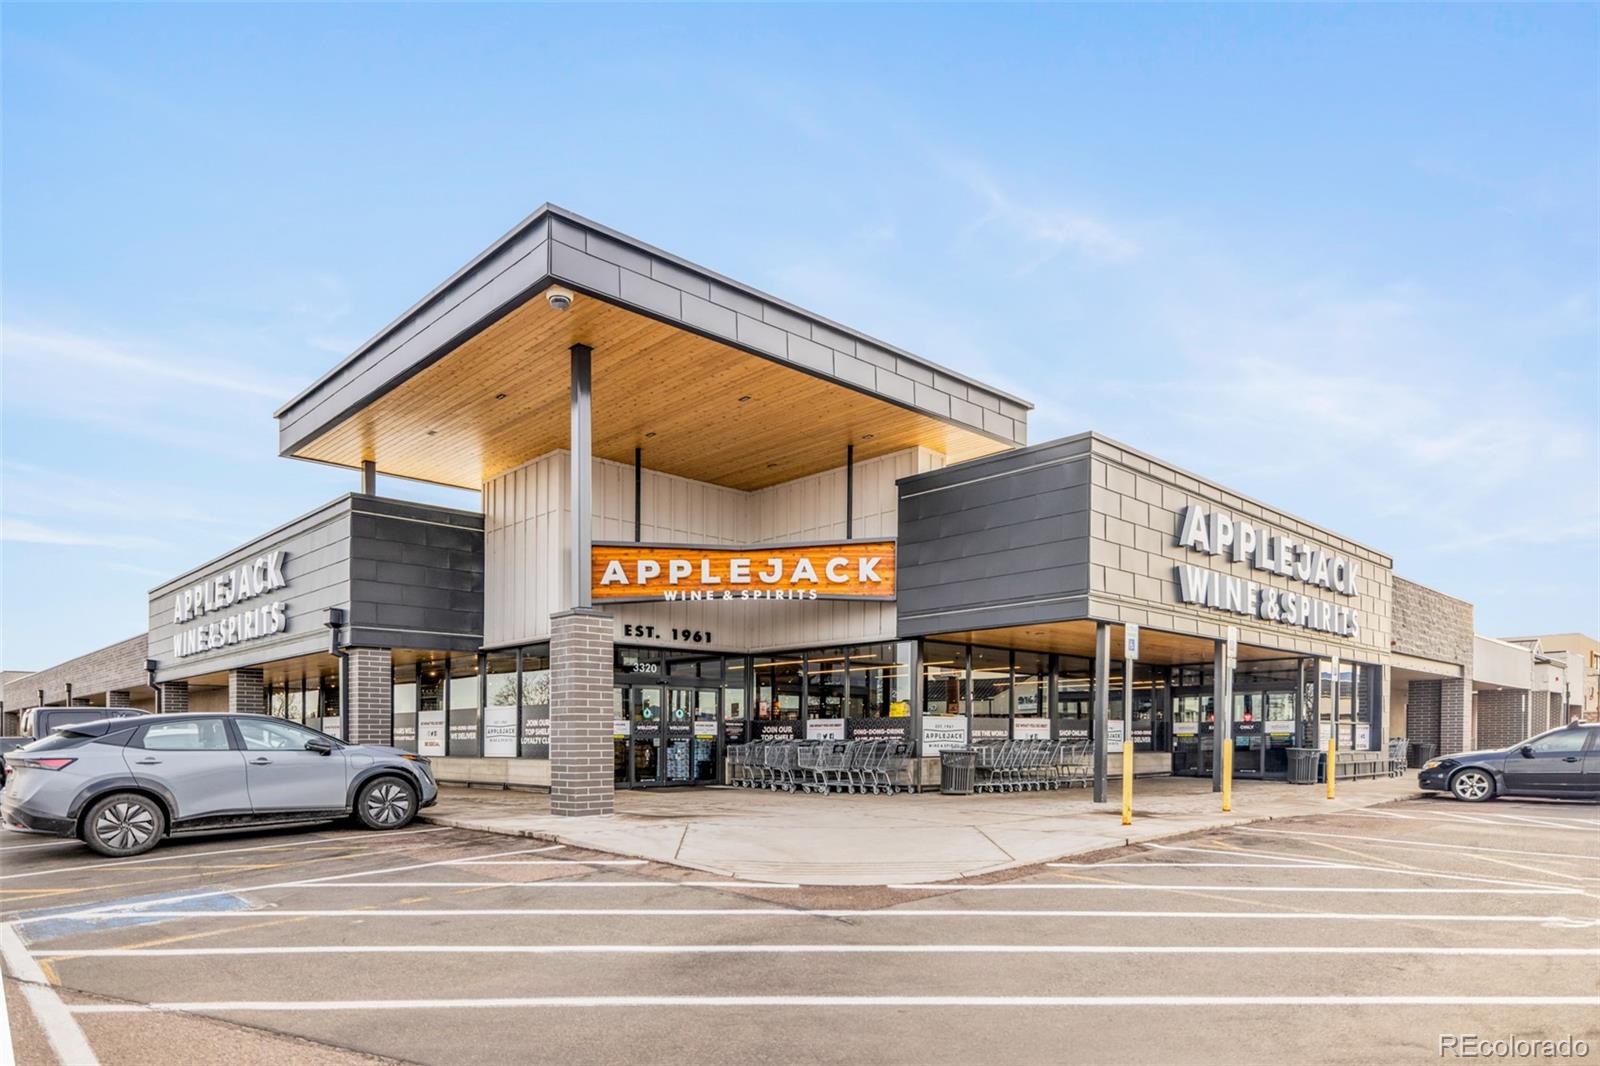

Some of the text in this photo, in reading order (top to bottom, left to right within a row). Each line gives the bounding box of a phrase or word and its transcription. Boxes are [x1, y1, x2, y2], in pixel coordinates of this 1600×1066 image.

[1178, 504, 1360, 596] APPLEJACK
[600, 557, 882, 585] APPLEJACK
[174, 550, 287, 624] APPLEJACK
[663, 588, 818, 601] WINE & SPIRITS
[1177, 563, 1259, 615] WINE
[624, 624, 712, 643] EST. 1961
[633, 662, 658, 673] 3320
[778, 726, 793, 734] OUR
